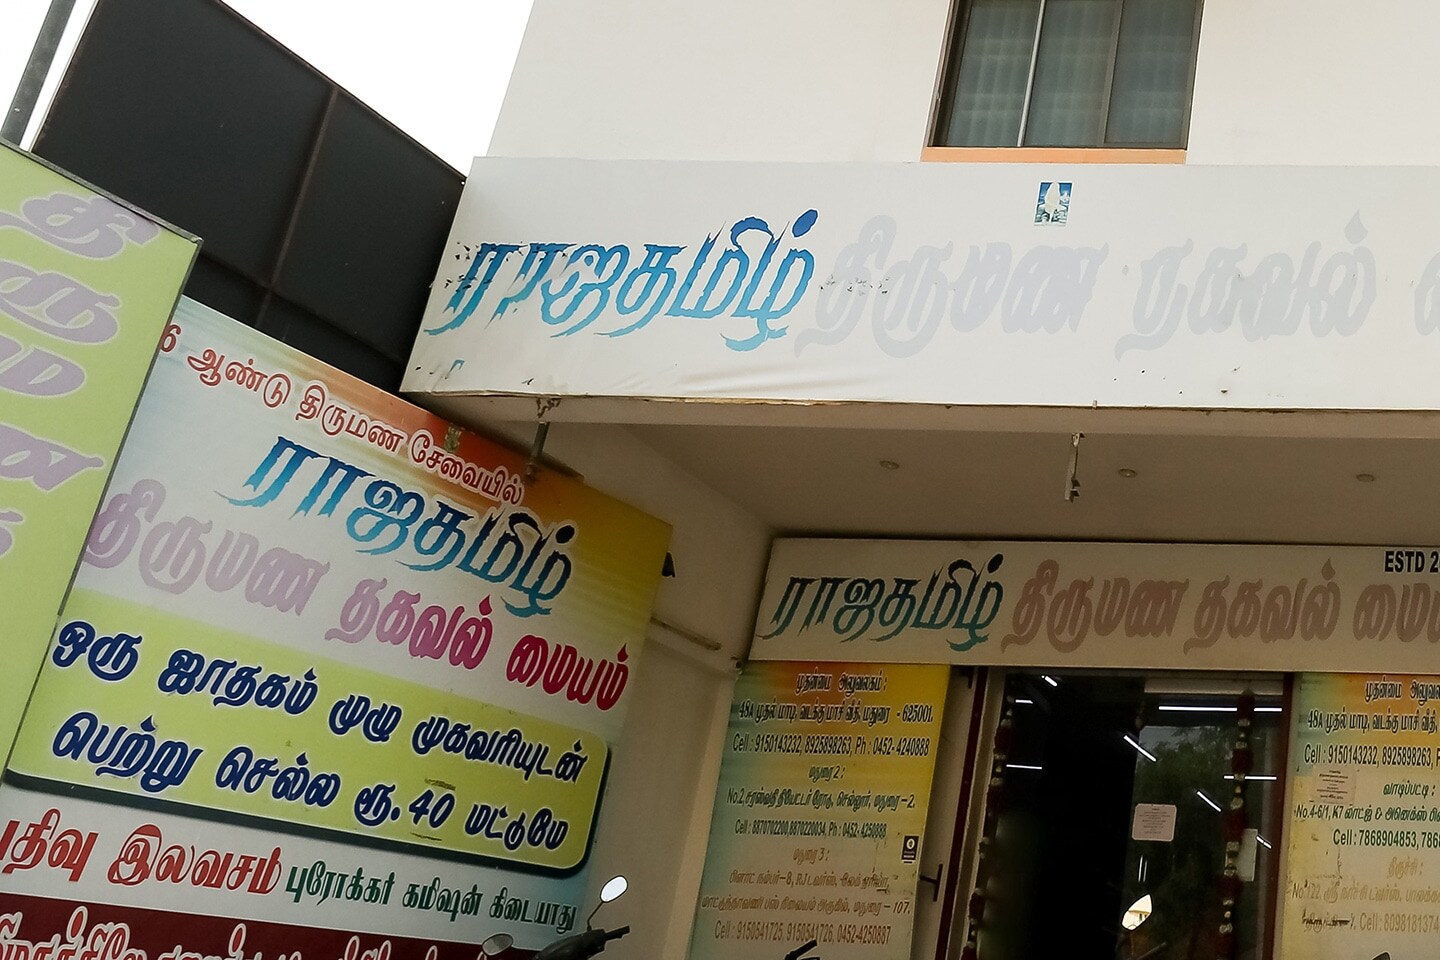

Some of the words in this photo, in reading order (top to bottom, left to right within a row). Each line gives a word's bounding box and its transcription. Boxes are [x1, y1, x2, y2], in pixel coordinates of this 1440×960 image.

[424, 208, 819, 352] ராஜதமிழ்
[794, 215, 1109, 358] திருமண
[1115, 208, 1378, 361] தகவல்
[187, 346, 291, 407] ஆண்டு
[295, 386, 404, 455] திருமண
[409, 430, 526, 506] சேவையில்
[214, 435, 576, 617] ராஜதமிழ்
[1384, 550, 1425, 574] ESTD
[83, 478, 331, 615] திருமண
[325, 575, 496, 671] தகவல்
[505, 632, 631, 711] மையம்
[757, 552, 1006, 653] ராஜதமிழ்
[1003, 558, 1189, 652] திருமண
[1184, 557, 1340, 655] தகவல்
[51, 620, 144, 682] ஒரு
[157, 646, 319, 715] ஜாதகம்
[329, 690, 403, 743] முழு
[411, 712, 588, 786] முகவரியுடன்
[733, 733, 749, 751] Cell
[1365, 676, 1402, 703] முதன்மை
[52, 711, 204, 793] பெற்று
[215, 744, 341, 808] செல்ல
[464, 804, 570, 851] மட்டுமே
[1304, 744, 1322, 764] Cell
[1328, 745, 1379, 768] 9150143232,
[1382, 747, 1433, 770] 8925898263,
[107, 824, 282, 895] இலவசம்
[286, 859, 395, 906] புரோக்கர்
[402, 868, 482, 922] கமிஷன்
[488, 888, 578, 935] கிடையாது
[1333, 828, 1353, 845] Cell
[1359, 829, 1419, 850] 7868904853,
